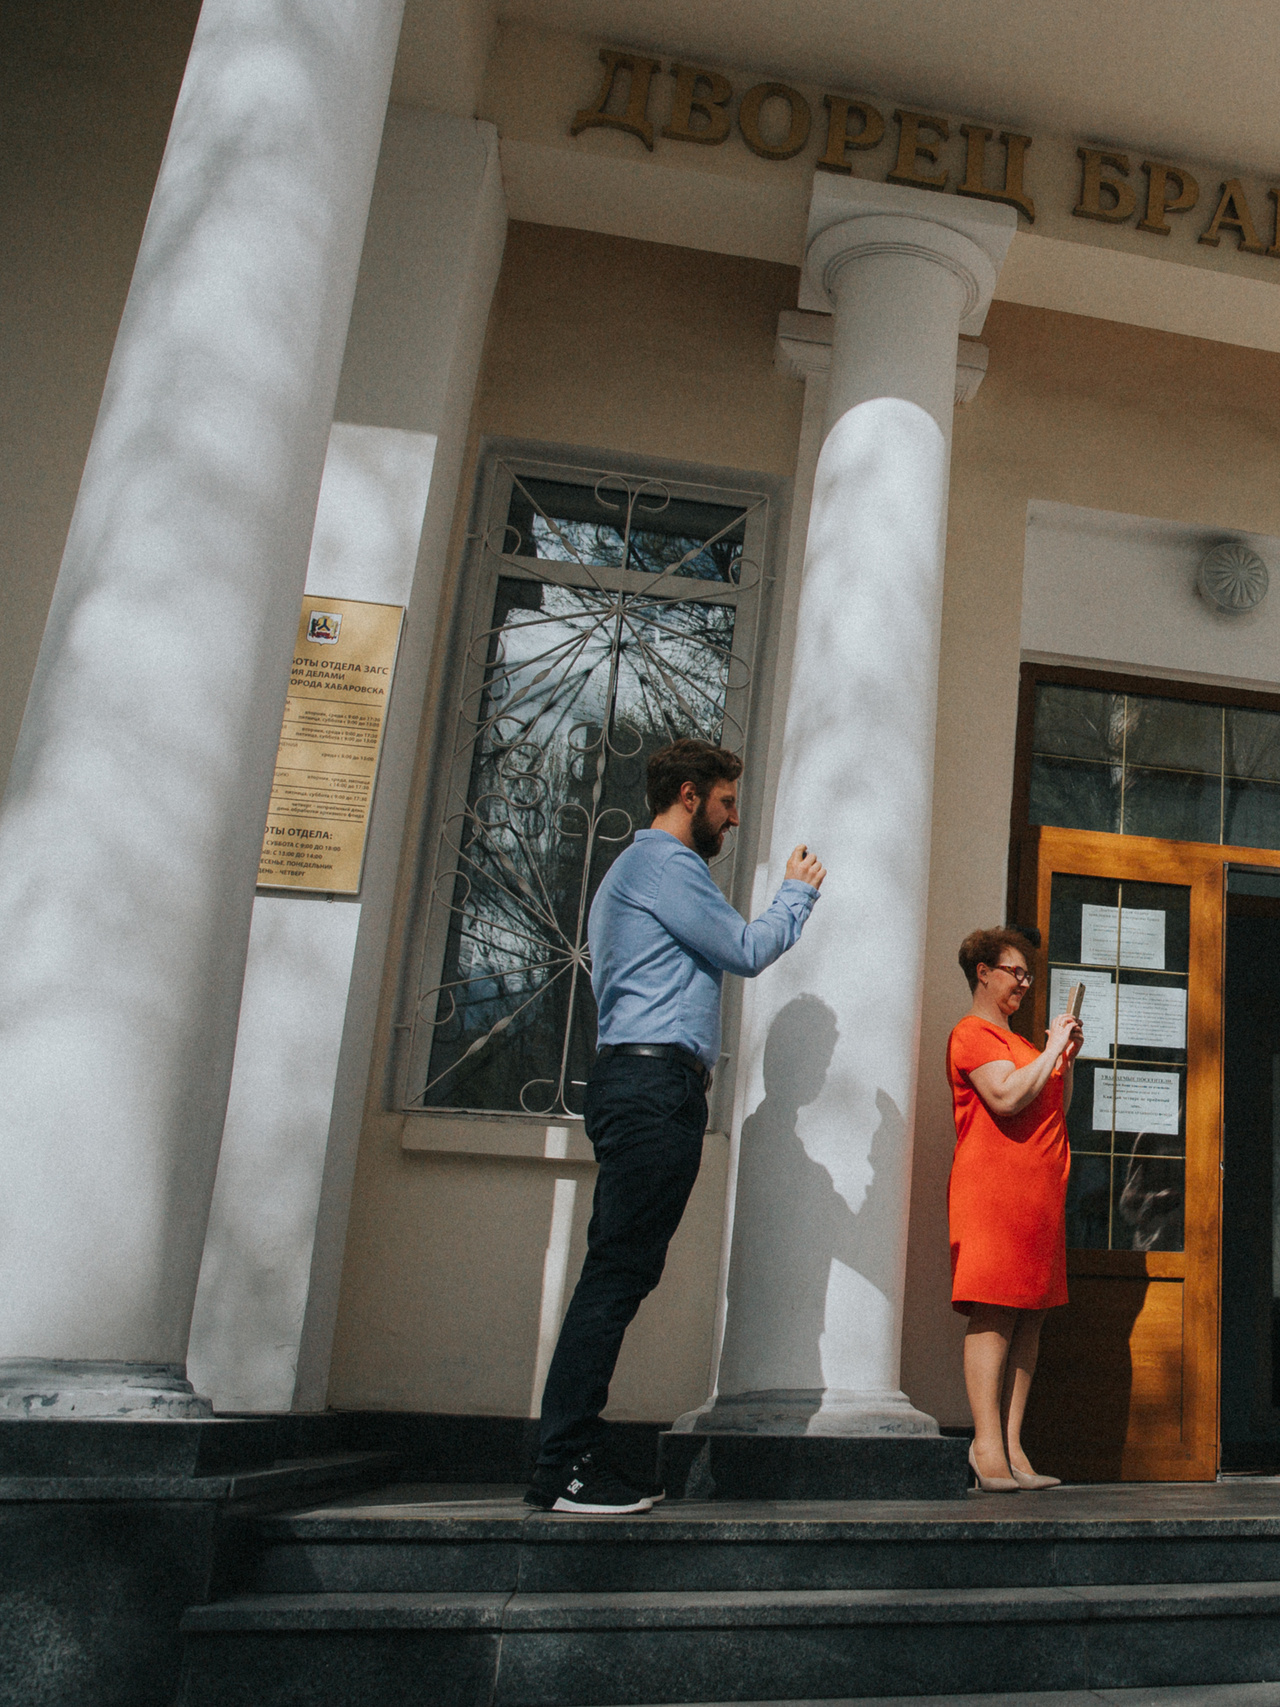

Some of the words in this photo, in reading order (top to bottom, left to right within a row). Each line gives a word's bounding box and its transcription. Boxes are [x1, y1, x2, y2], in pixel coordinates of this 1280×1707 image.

[569, 48, 1034, 223] ДВОРЕЦ
[321, 660, 361, 673] ОТДЕЛА
[364, 665, 389, 675] ЗАГС
[305, 670, 345, 680] ДЕЛАМИ
[325, 682, 385, 694] ХАБАРОВСКА
[288, 828, 333, 840] ОТДЕЛА:
[286, 860, 333, 870] ПОНЕДЕЛЬНИК
